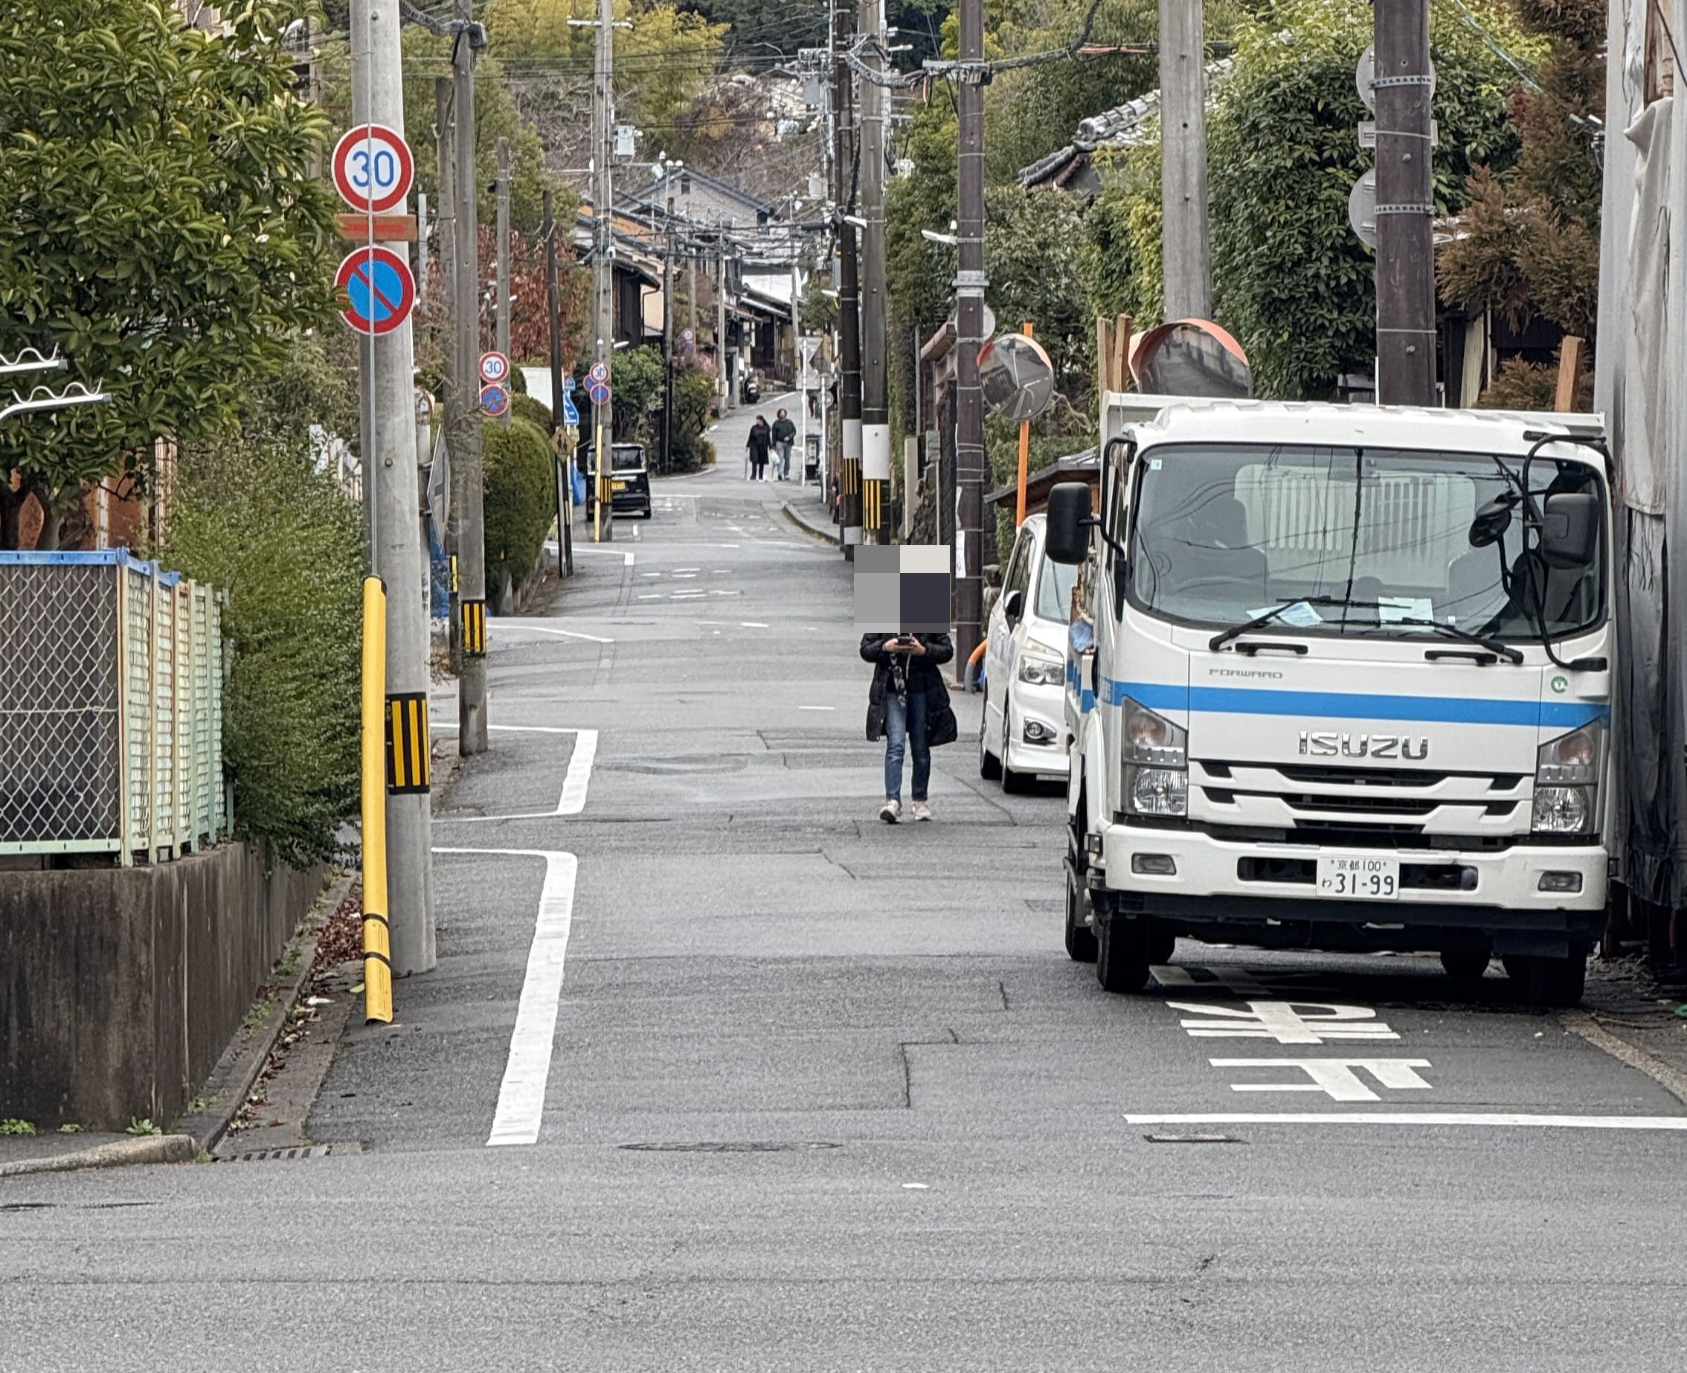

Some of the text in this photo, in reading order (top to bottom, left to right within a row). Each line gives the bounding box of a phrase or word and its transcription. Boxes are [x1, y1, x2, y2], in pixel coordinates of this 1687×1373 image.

[352, 150, 395, 188] 30
[485, 360, 502, 374] 30
[1208, 668, 1284, 679] FORWARD
[1298, 730, 1429, 760] ISUZU
[1335, 872, 1395, 896] 31-99
